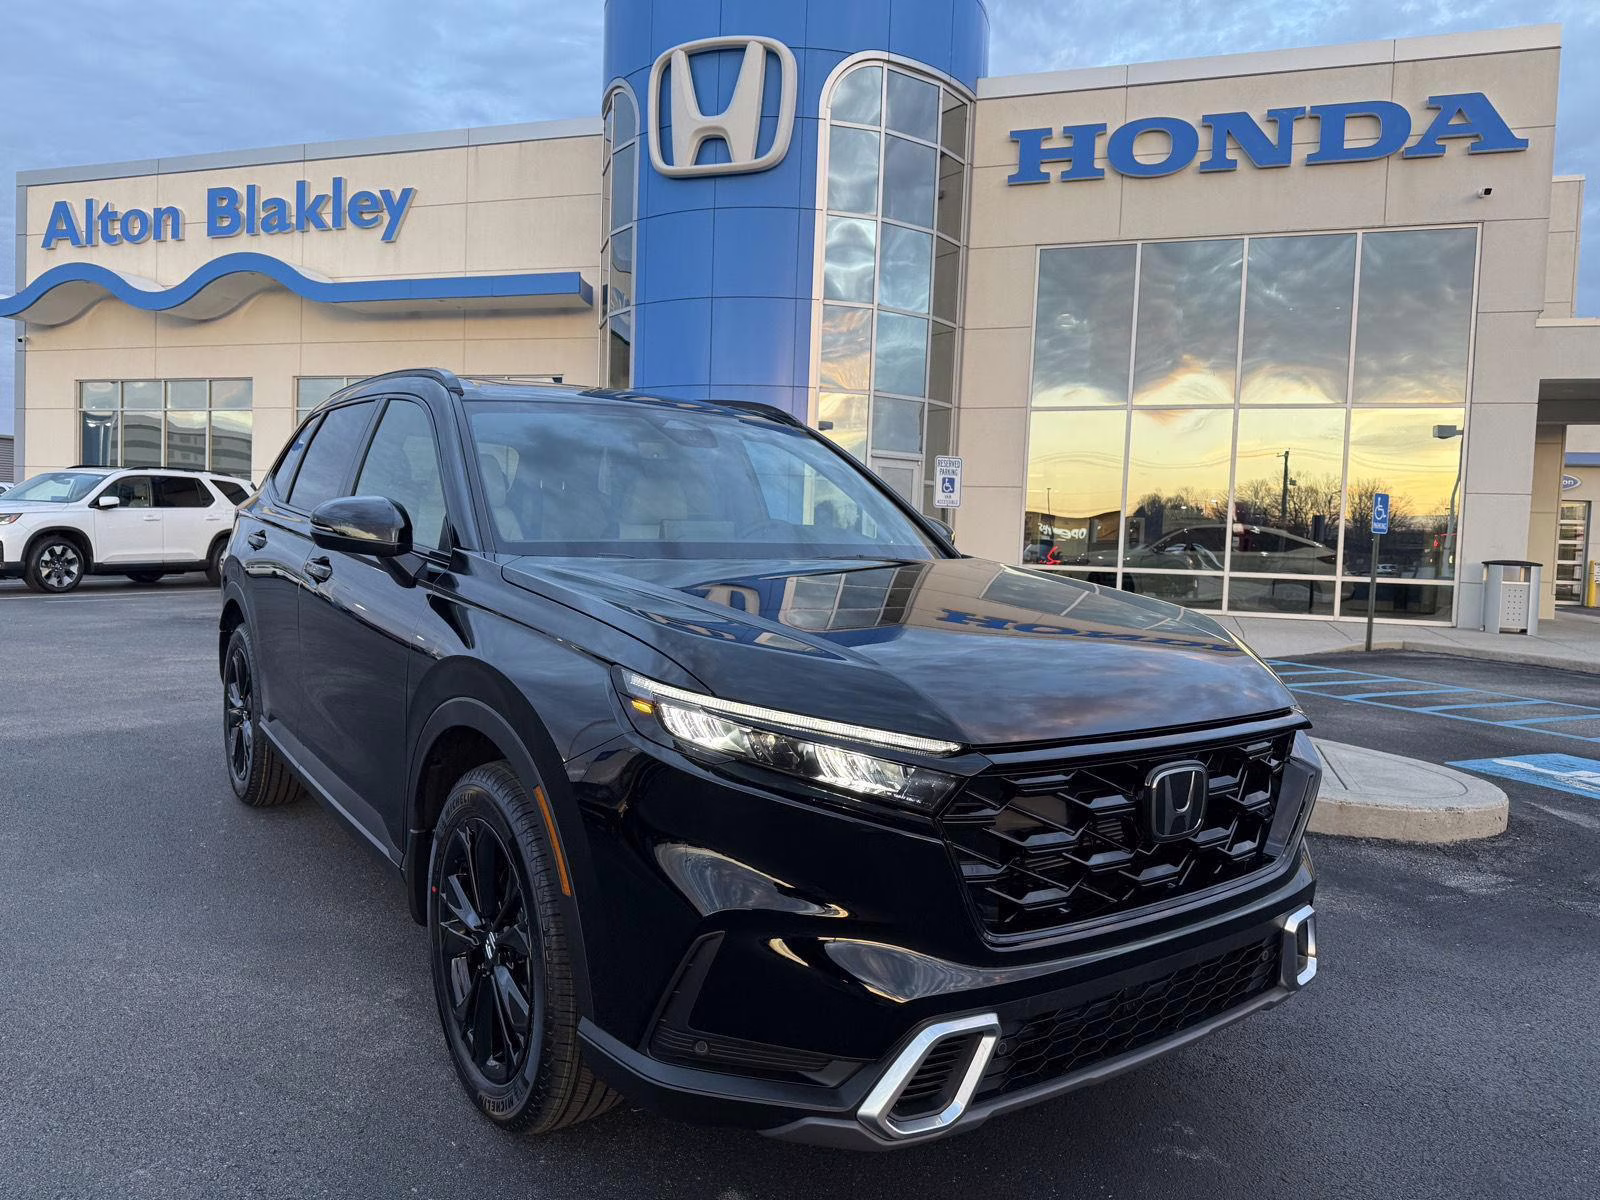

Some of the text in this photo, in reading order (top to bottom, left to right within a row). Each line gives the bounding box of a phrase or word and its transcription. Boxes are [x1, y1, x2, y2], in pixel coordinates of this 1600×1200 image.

[1008, 92, 1529, 186] HONDA
[41, 176, 418, 250] Alton Blakley
[937, 459, 960, 469] RESERVED
[939, 468, 958, 476] PARKING
[478, 1094, 514, 1113] MICHELIN
